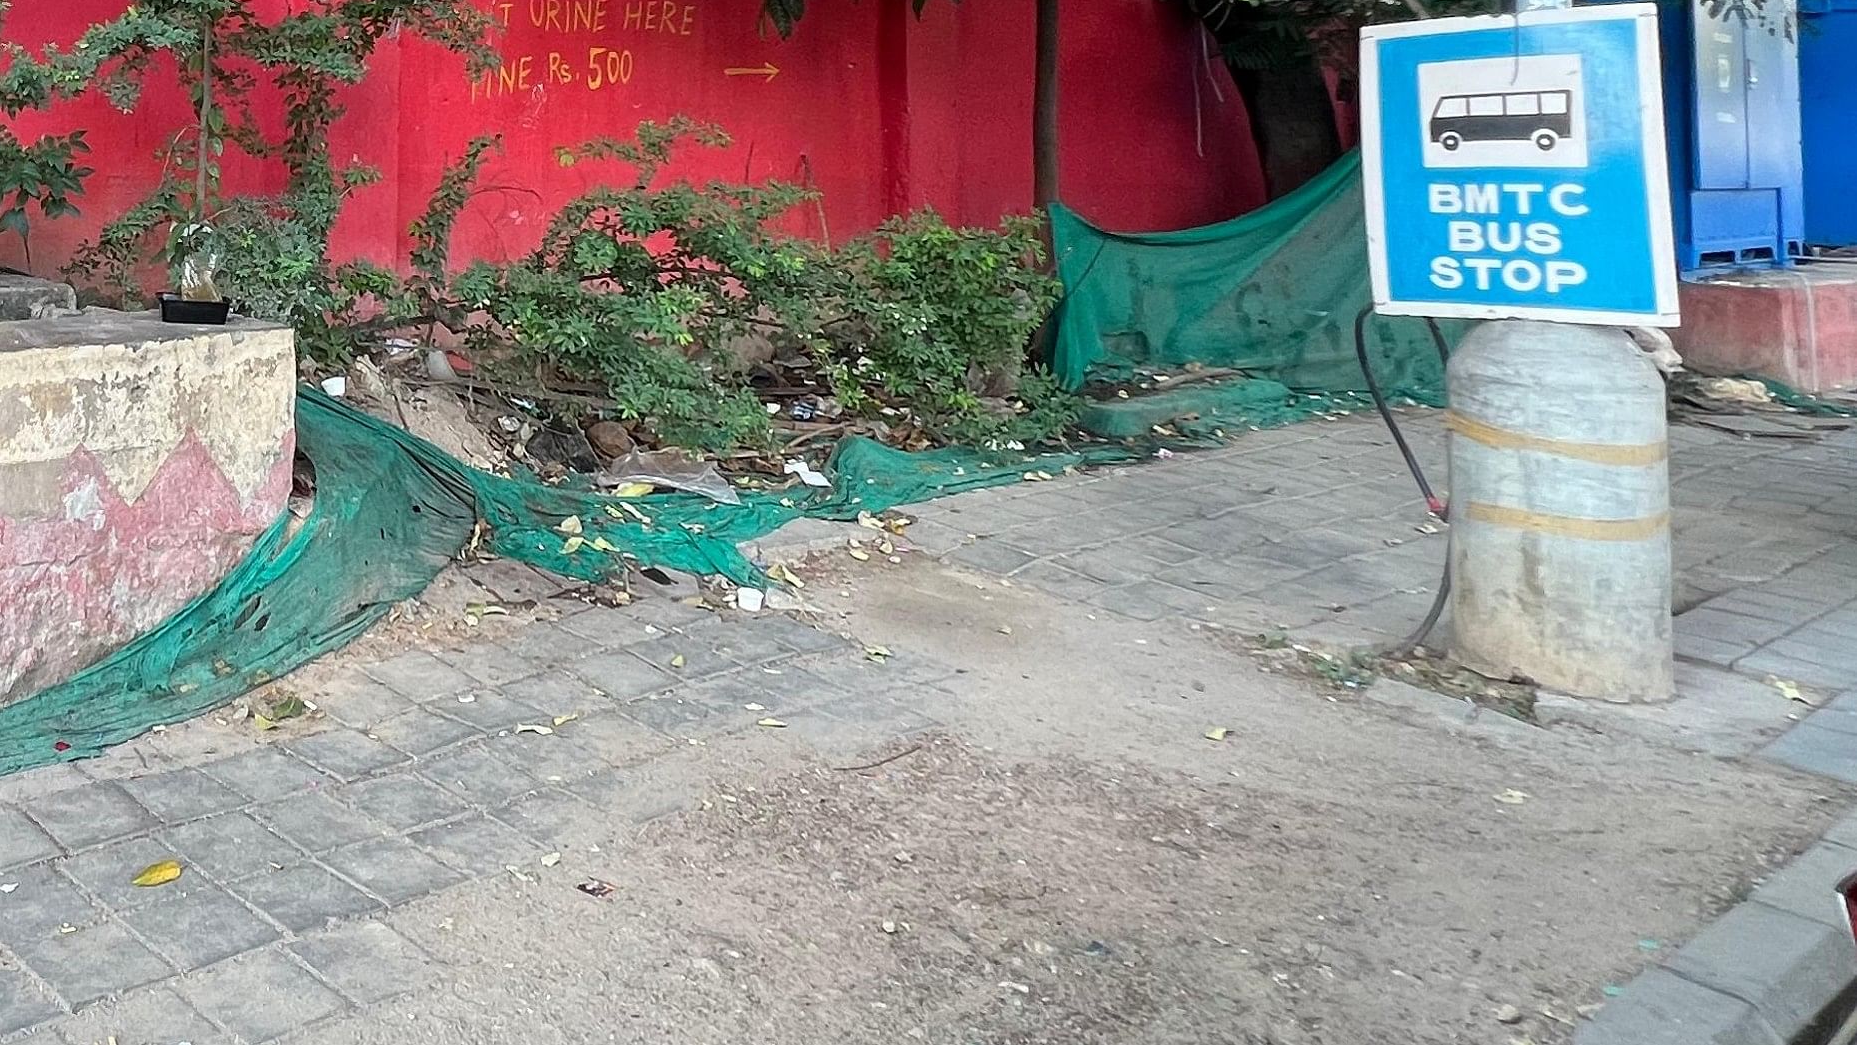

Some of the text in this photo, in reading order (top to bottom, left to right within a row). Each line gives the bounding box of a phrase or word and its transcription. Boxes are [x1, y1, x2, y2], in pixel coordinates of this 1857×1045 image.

[624, 1, 695, 35] HERE
[549, 52, 580, 84] Rs.
[587, 48, 633, 90] 500
[1428, 182, 1590, 216] BMTC
[1449, 221, 1562, 254] BUS
[1429, 257, 1588, 293] STOP
